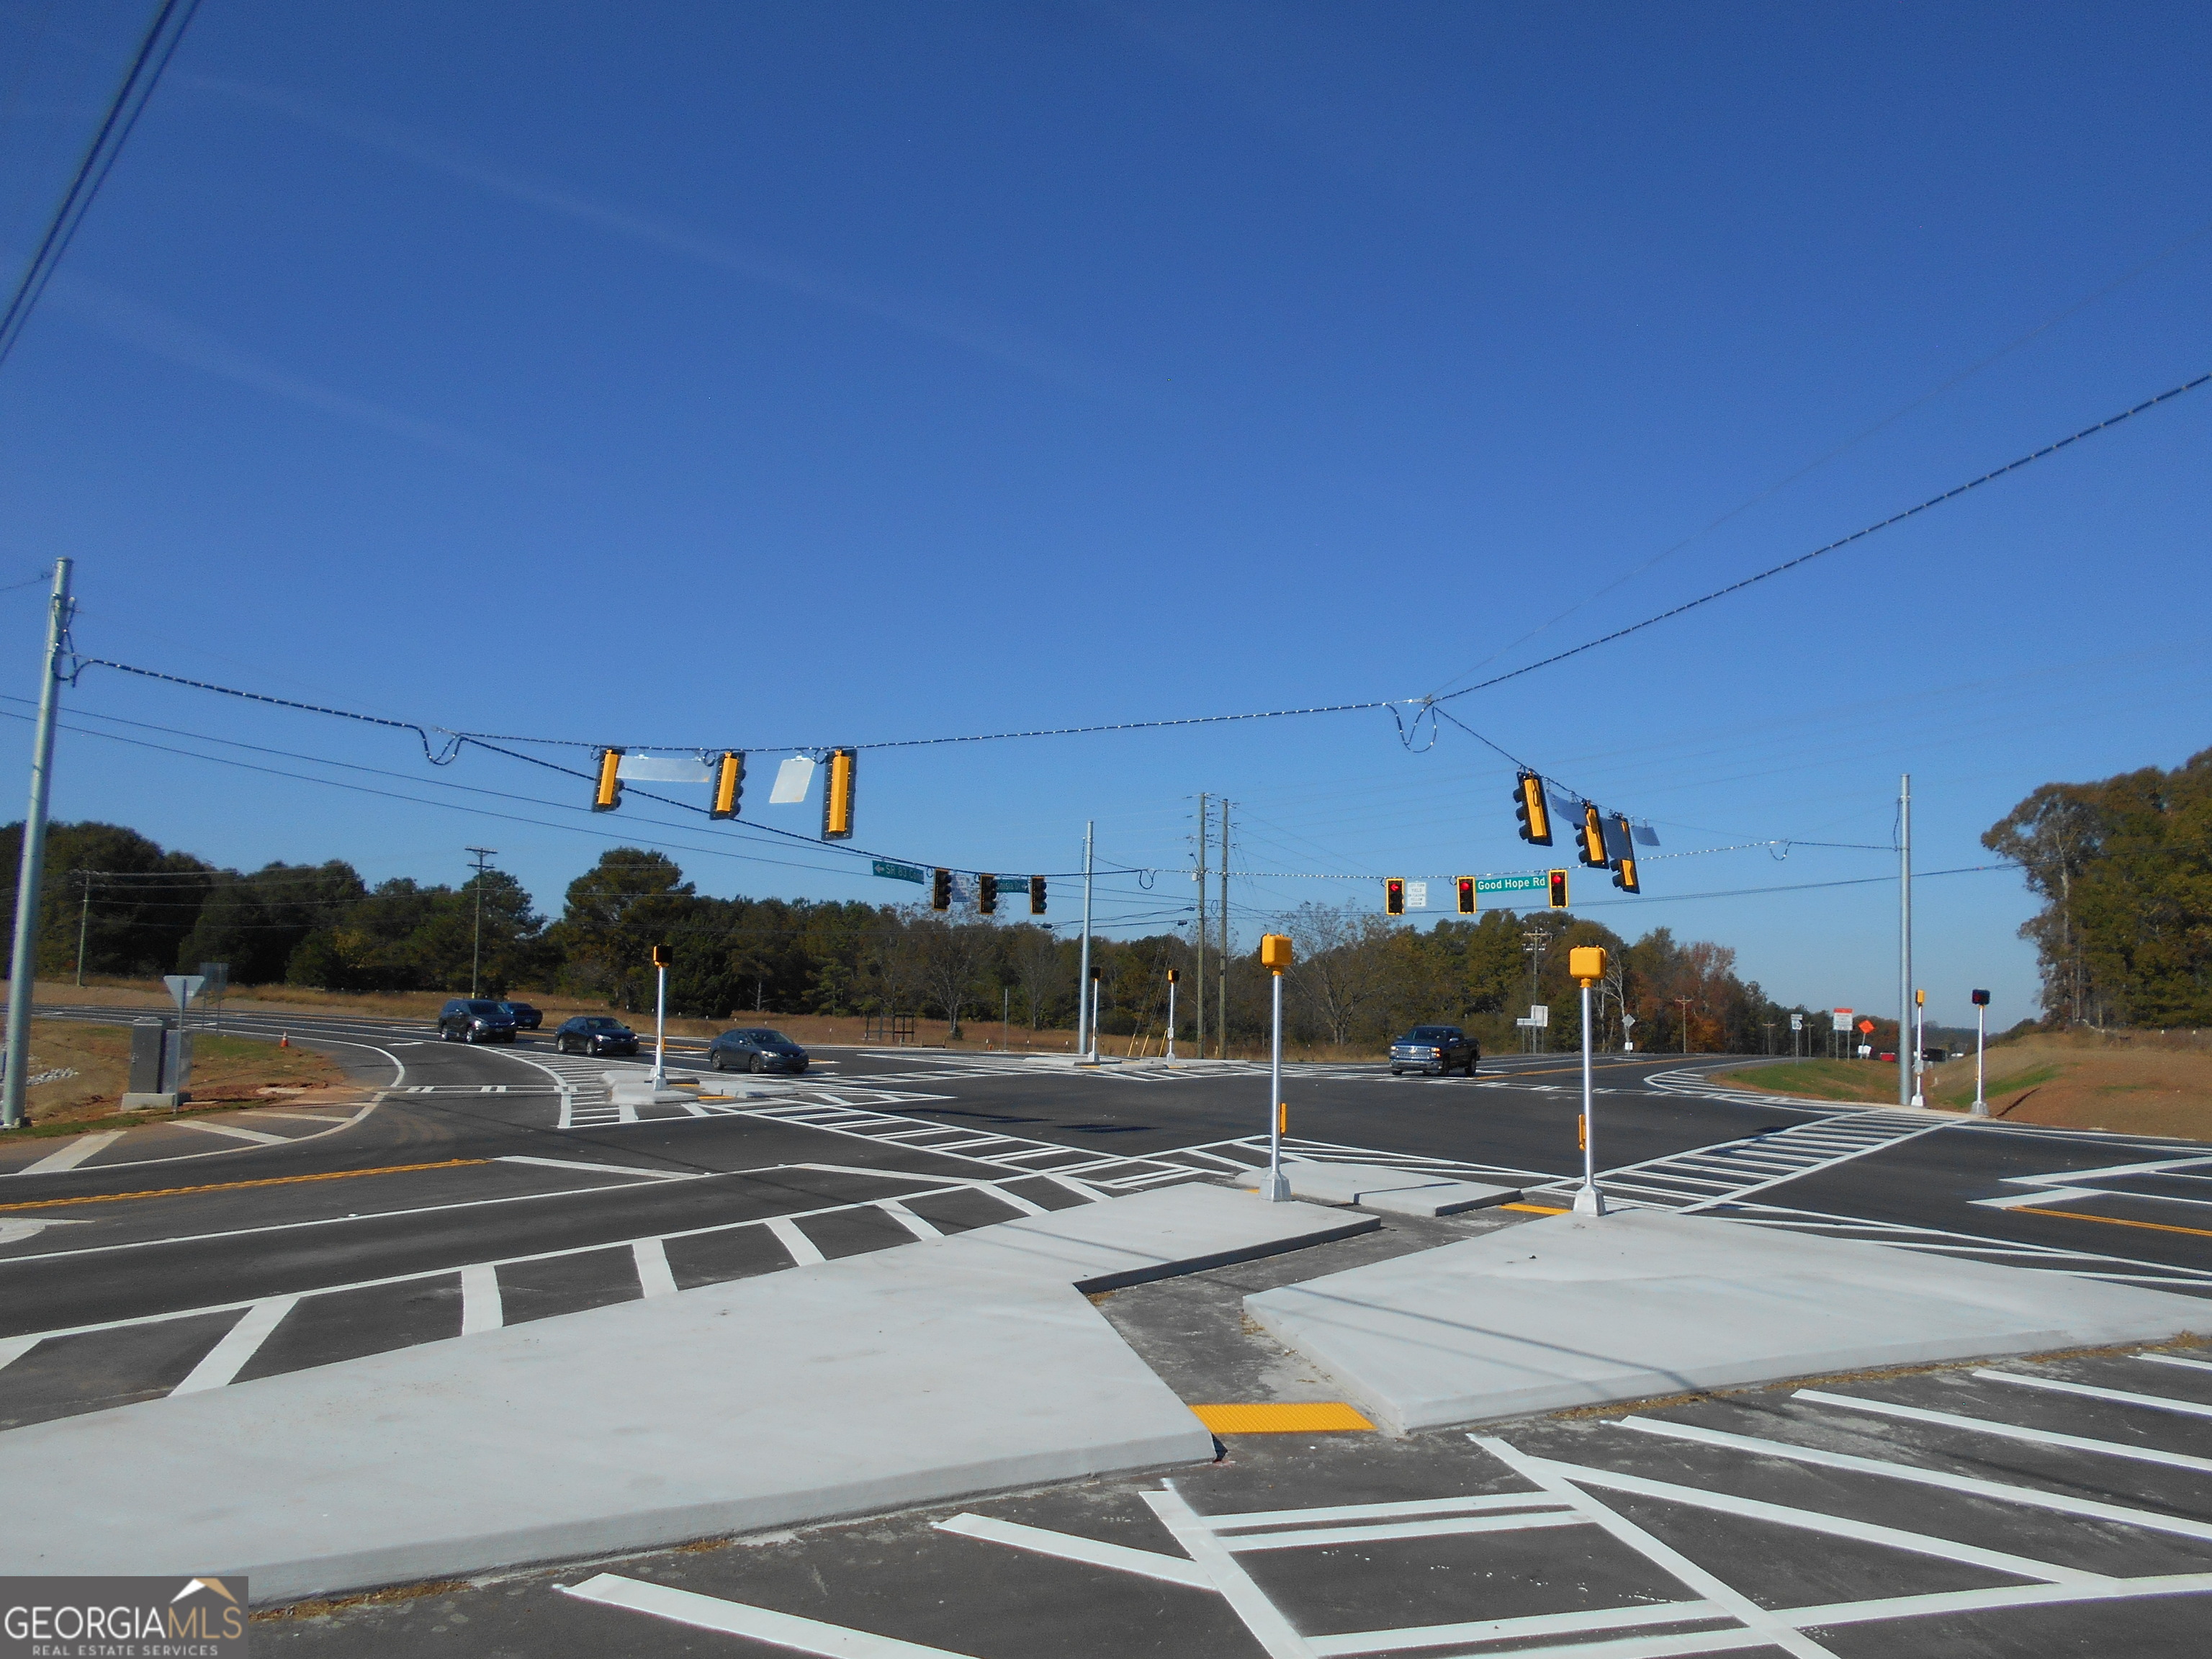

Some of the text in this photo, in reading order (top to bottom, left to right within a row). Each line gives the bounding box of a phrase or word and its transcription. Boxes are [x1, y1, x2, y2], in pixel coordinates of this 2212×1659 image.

[885, 864, 896, 876] SR
[1478, 876, 1546, 890] Good Hope Rd
